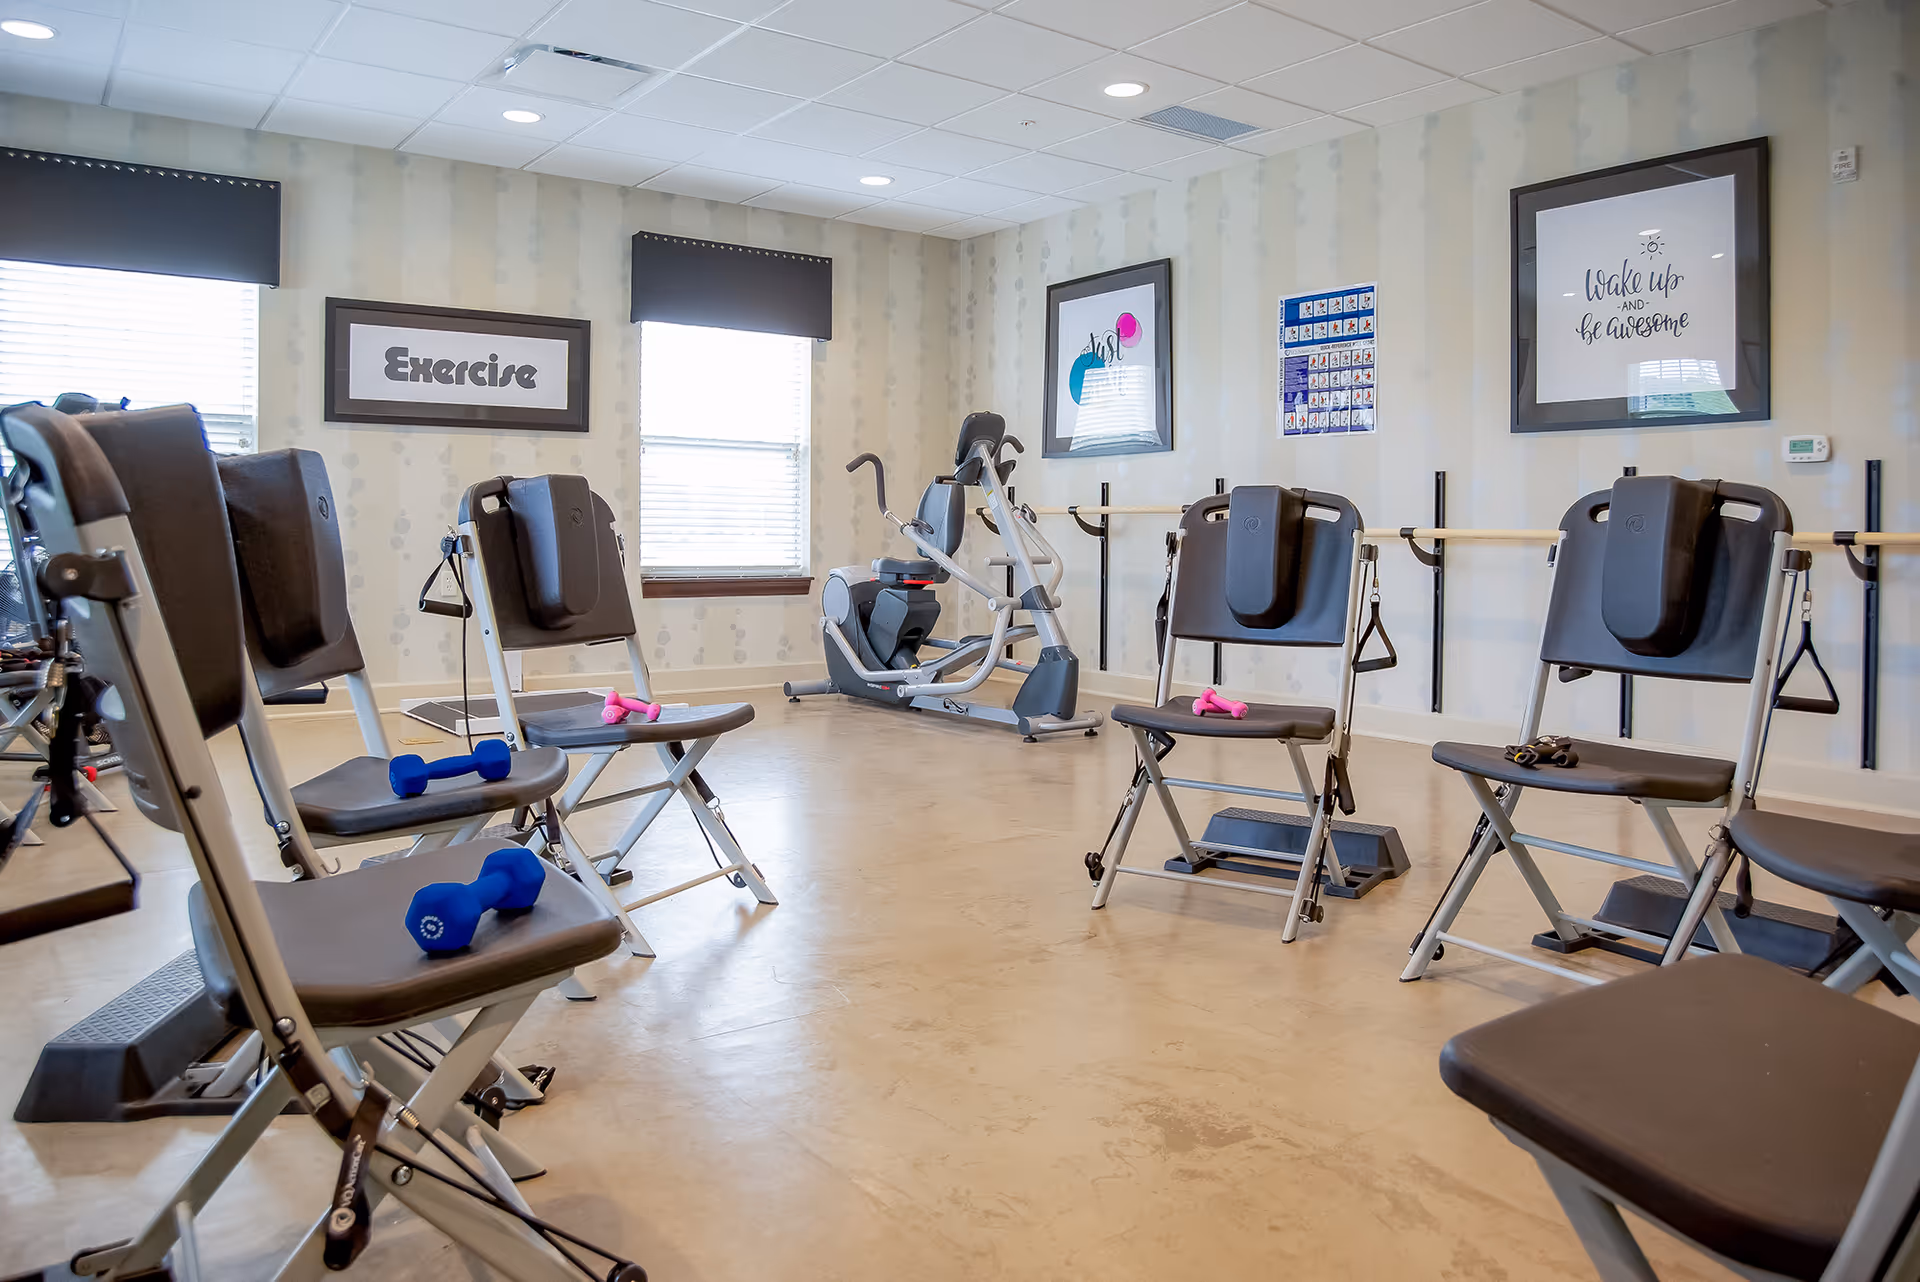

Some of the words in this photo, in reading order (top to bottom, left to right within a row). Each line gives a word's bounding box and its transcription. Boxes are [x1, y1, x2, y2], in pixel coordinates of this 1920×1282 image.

[1834, 161, 1852, 170] FIRE
[1585, 258, 1643, 302] Wake
[1649, 263, 1685, 298] up
[1080, 327, 1127, 367] Just
[1575, 312, 1603, 346] be
[1606, 312, 1690, 340] awesome
[384, 346, 537, 390] Exercise
